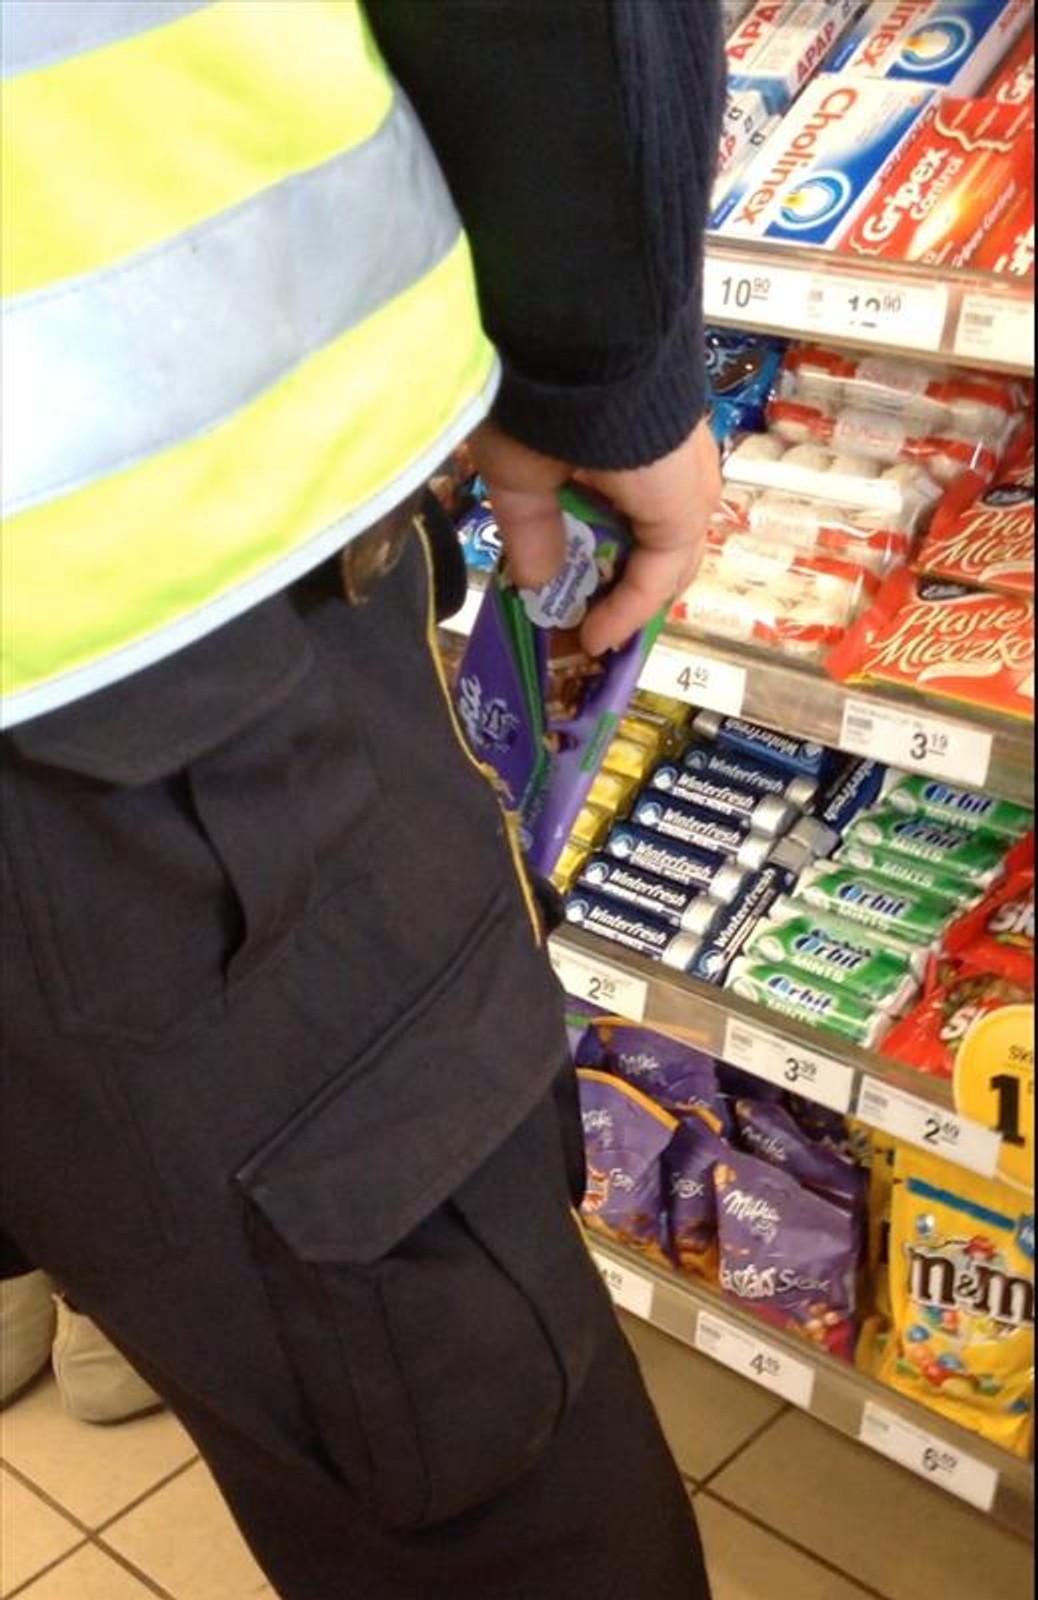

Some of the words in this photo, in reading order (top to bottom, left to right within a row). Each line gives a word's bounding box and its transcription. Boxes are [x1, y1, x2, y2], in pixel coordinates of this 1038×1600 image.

[797, 20, 835, 82] APAP
[733, 87, 858, 225] Cholinex
[862, 146, 950, 242] Gripex
[909, 155, 965, 220] Control
[677, 771, 756, 808] Winterfresh
[708, 755, 784, 793] Winterfresh
[923, 782, 994, 814] Orbit
[662, 806, 742, 844] Winterfresh
[634, 840, 712, 880] Winterfresh
[609, 867, 687, 908] Winterfresh
[838, 883, 906, 916] Orbit
[588, 905, 667, 946] Winterfresh
[713, 868, 777, 949] Winterfresh
[794, 934, 864, 969] Orbit
[767, 975, 833, 1012] Orbit
[722, 1189, 783, 1221] Milka
